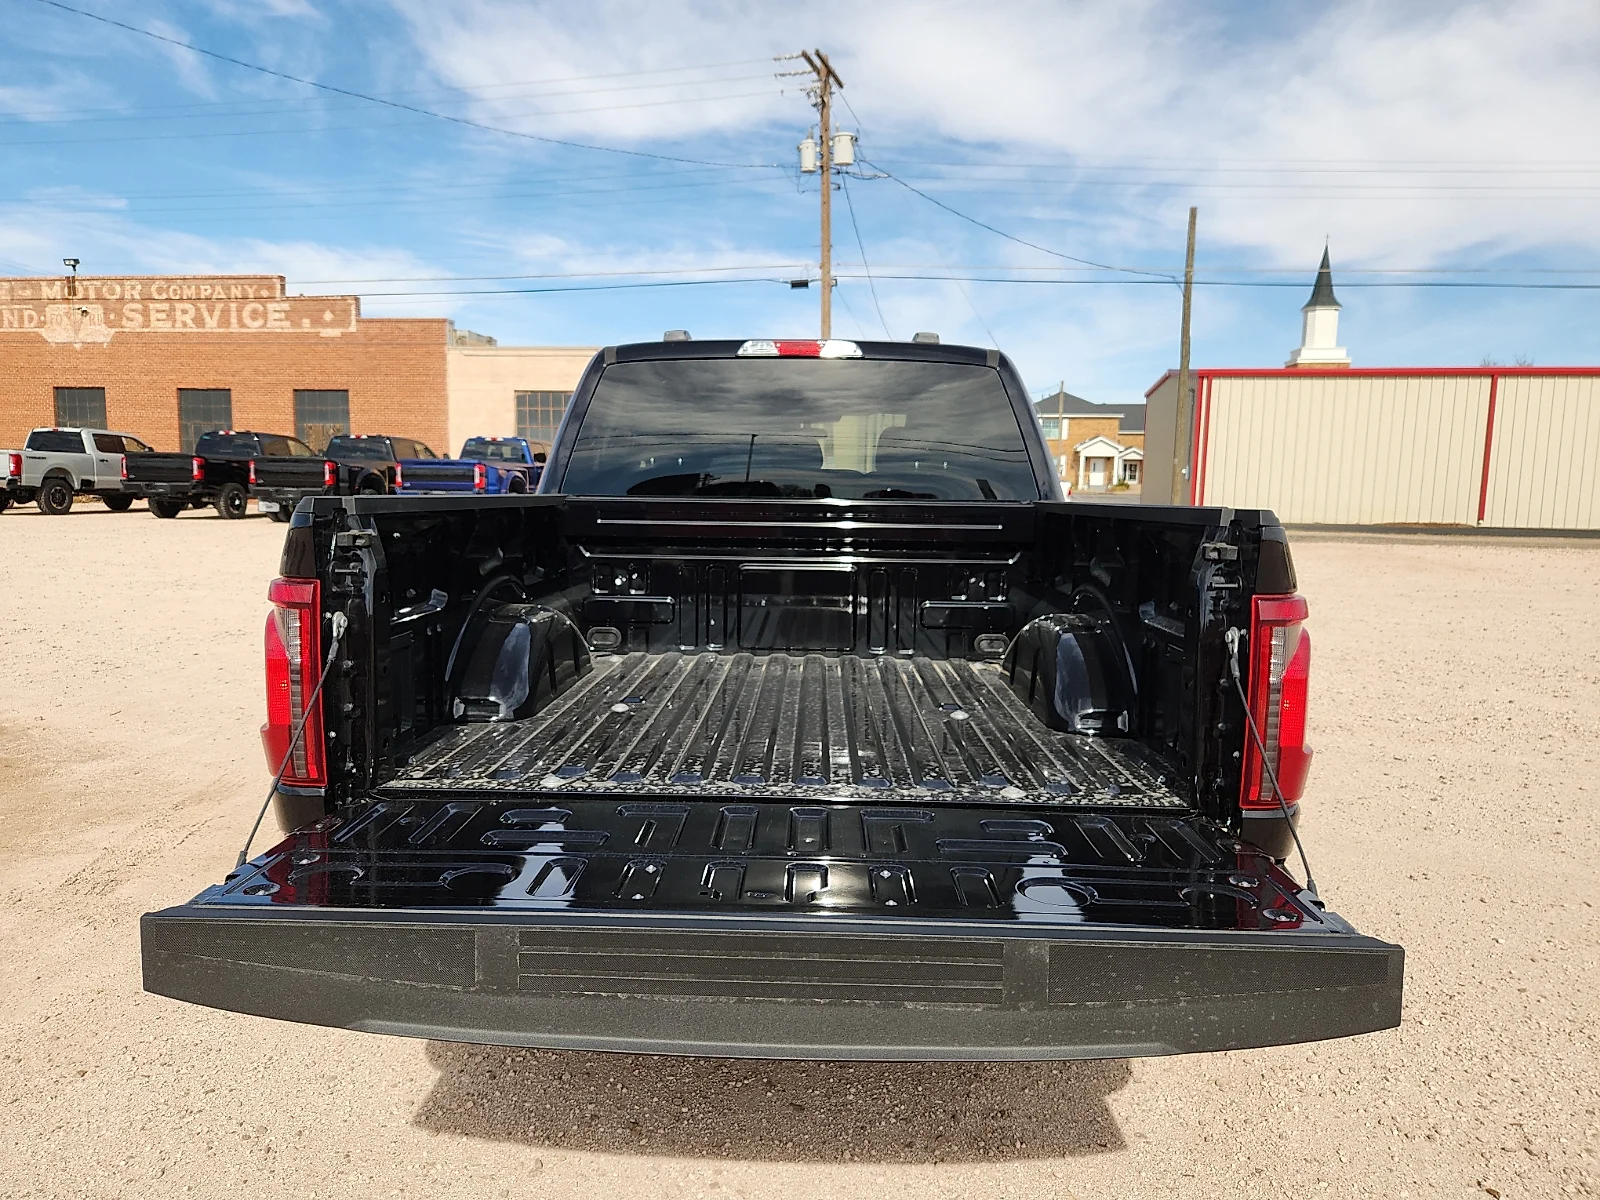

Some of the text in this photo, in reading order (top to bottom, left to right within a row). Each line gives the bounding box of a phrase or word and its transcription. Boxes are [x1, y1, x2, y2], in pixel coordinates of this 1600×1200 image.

[41, 281, 142, 299] MOTOR
[151, 281, 258, 299] COMPANY
[121, 303, 291, 329] SERVICE
